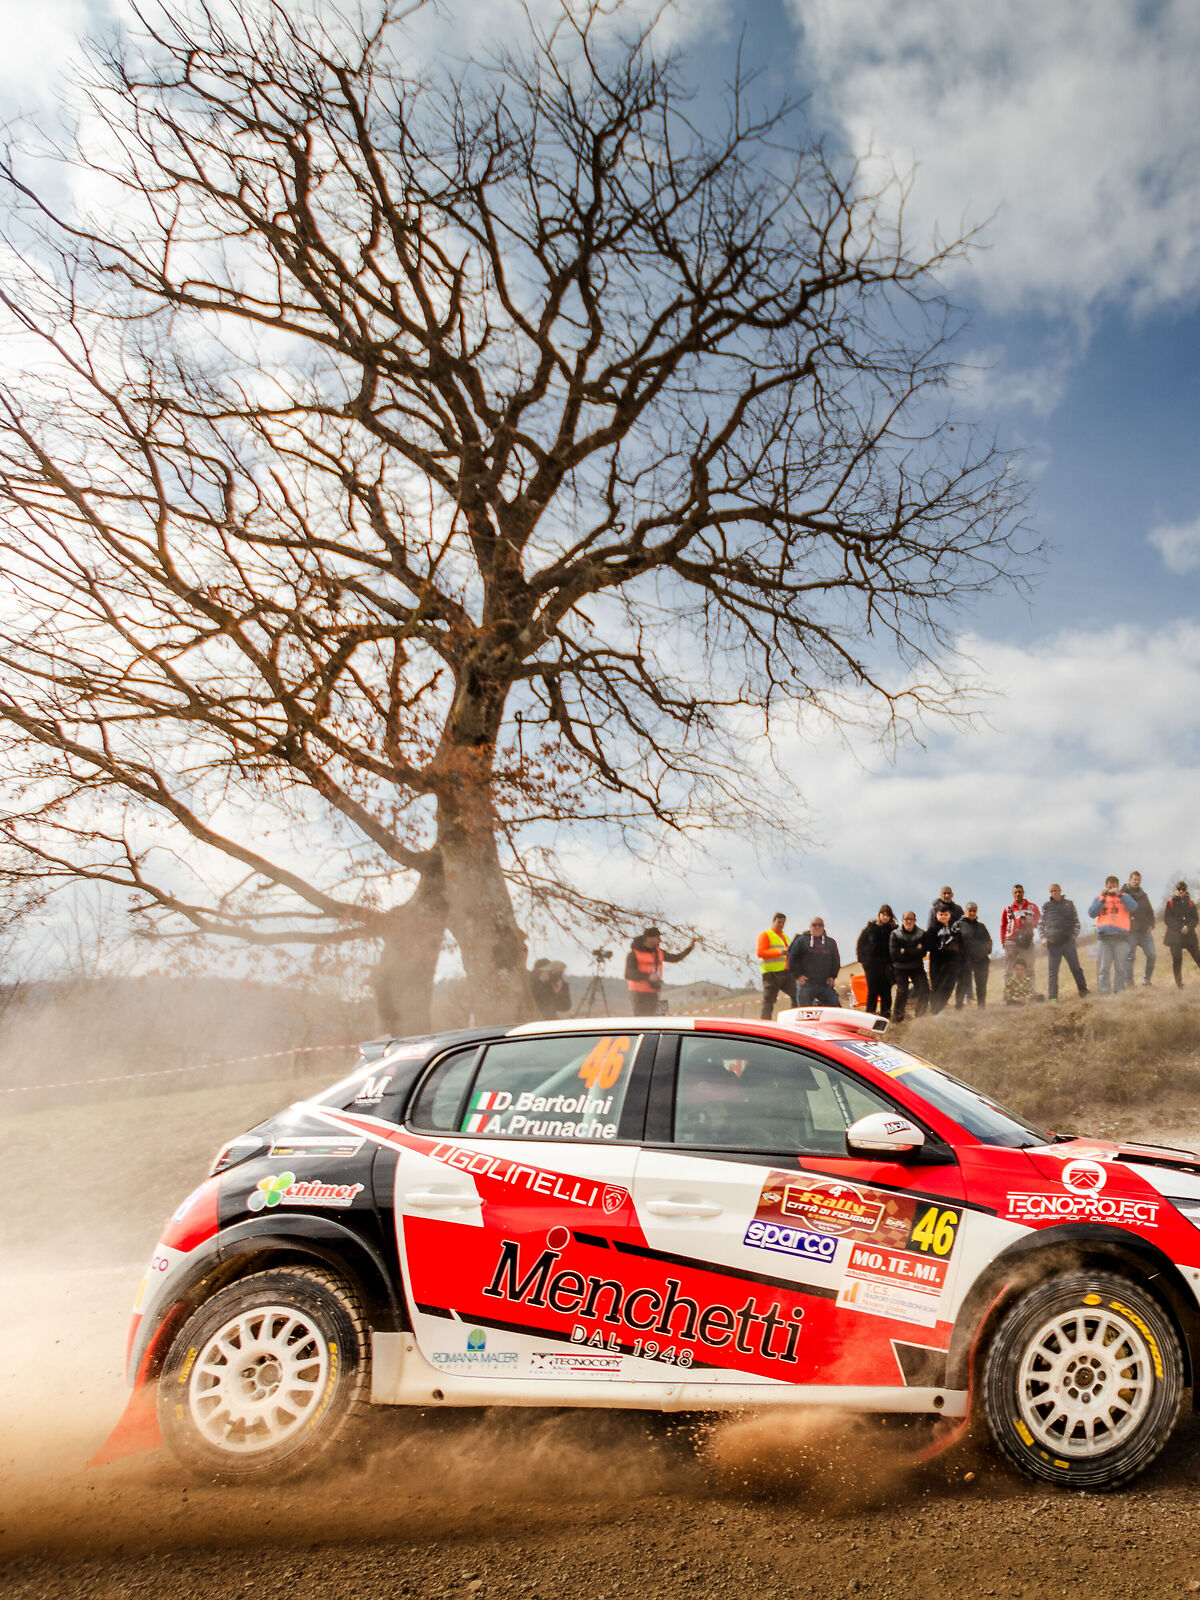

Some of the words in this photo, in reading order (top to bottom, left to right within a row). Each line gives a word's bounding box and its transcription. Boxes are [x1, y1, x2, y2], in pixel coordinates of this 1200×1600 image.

[578, 1036, 631, 1090] 46
[492, 1091, 614, 1115] D.Bartolini
[483, 1114, 617, 1139] A.Prunache
[428, 1143, 599, 1207] UGOLINELLI
[799, 1191, 867, 1216] Rally
[818, 1208, 830, 1216] DI
[1006, 1195, 1160, 1222] TECNOPROJECT
[748, 1222, 836, 1256] sparco
[911, 1207, 958, 1256] 46
[852, 1249, 941, 1283] MO.TE.MI.
[482, 1227, 805, 1364] Menchetti
[554, 1357, 623, 1367] TECNOCOPY
[570, 1324, 621, 1352] DAL
[633, 1338, 694, 1369] 1948
